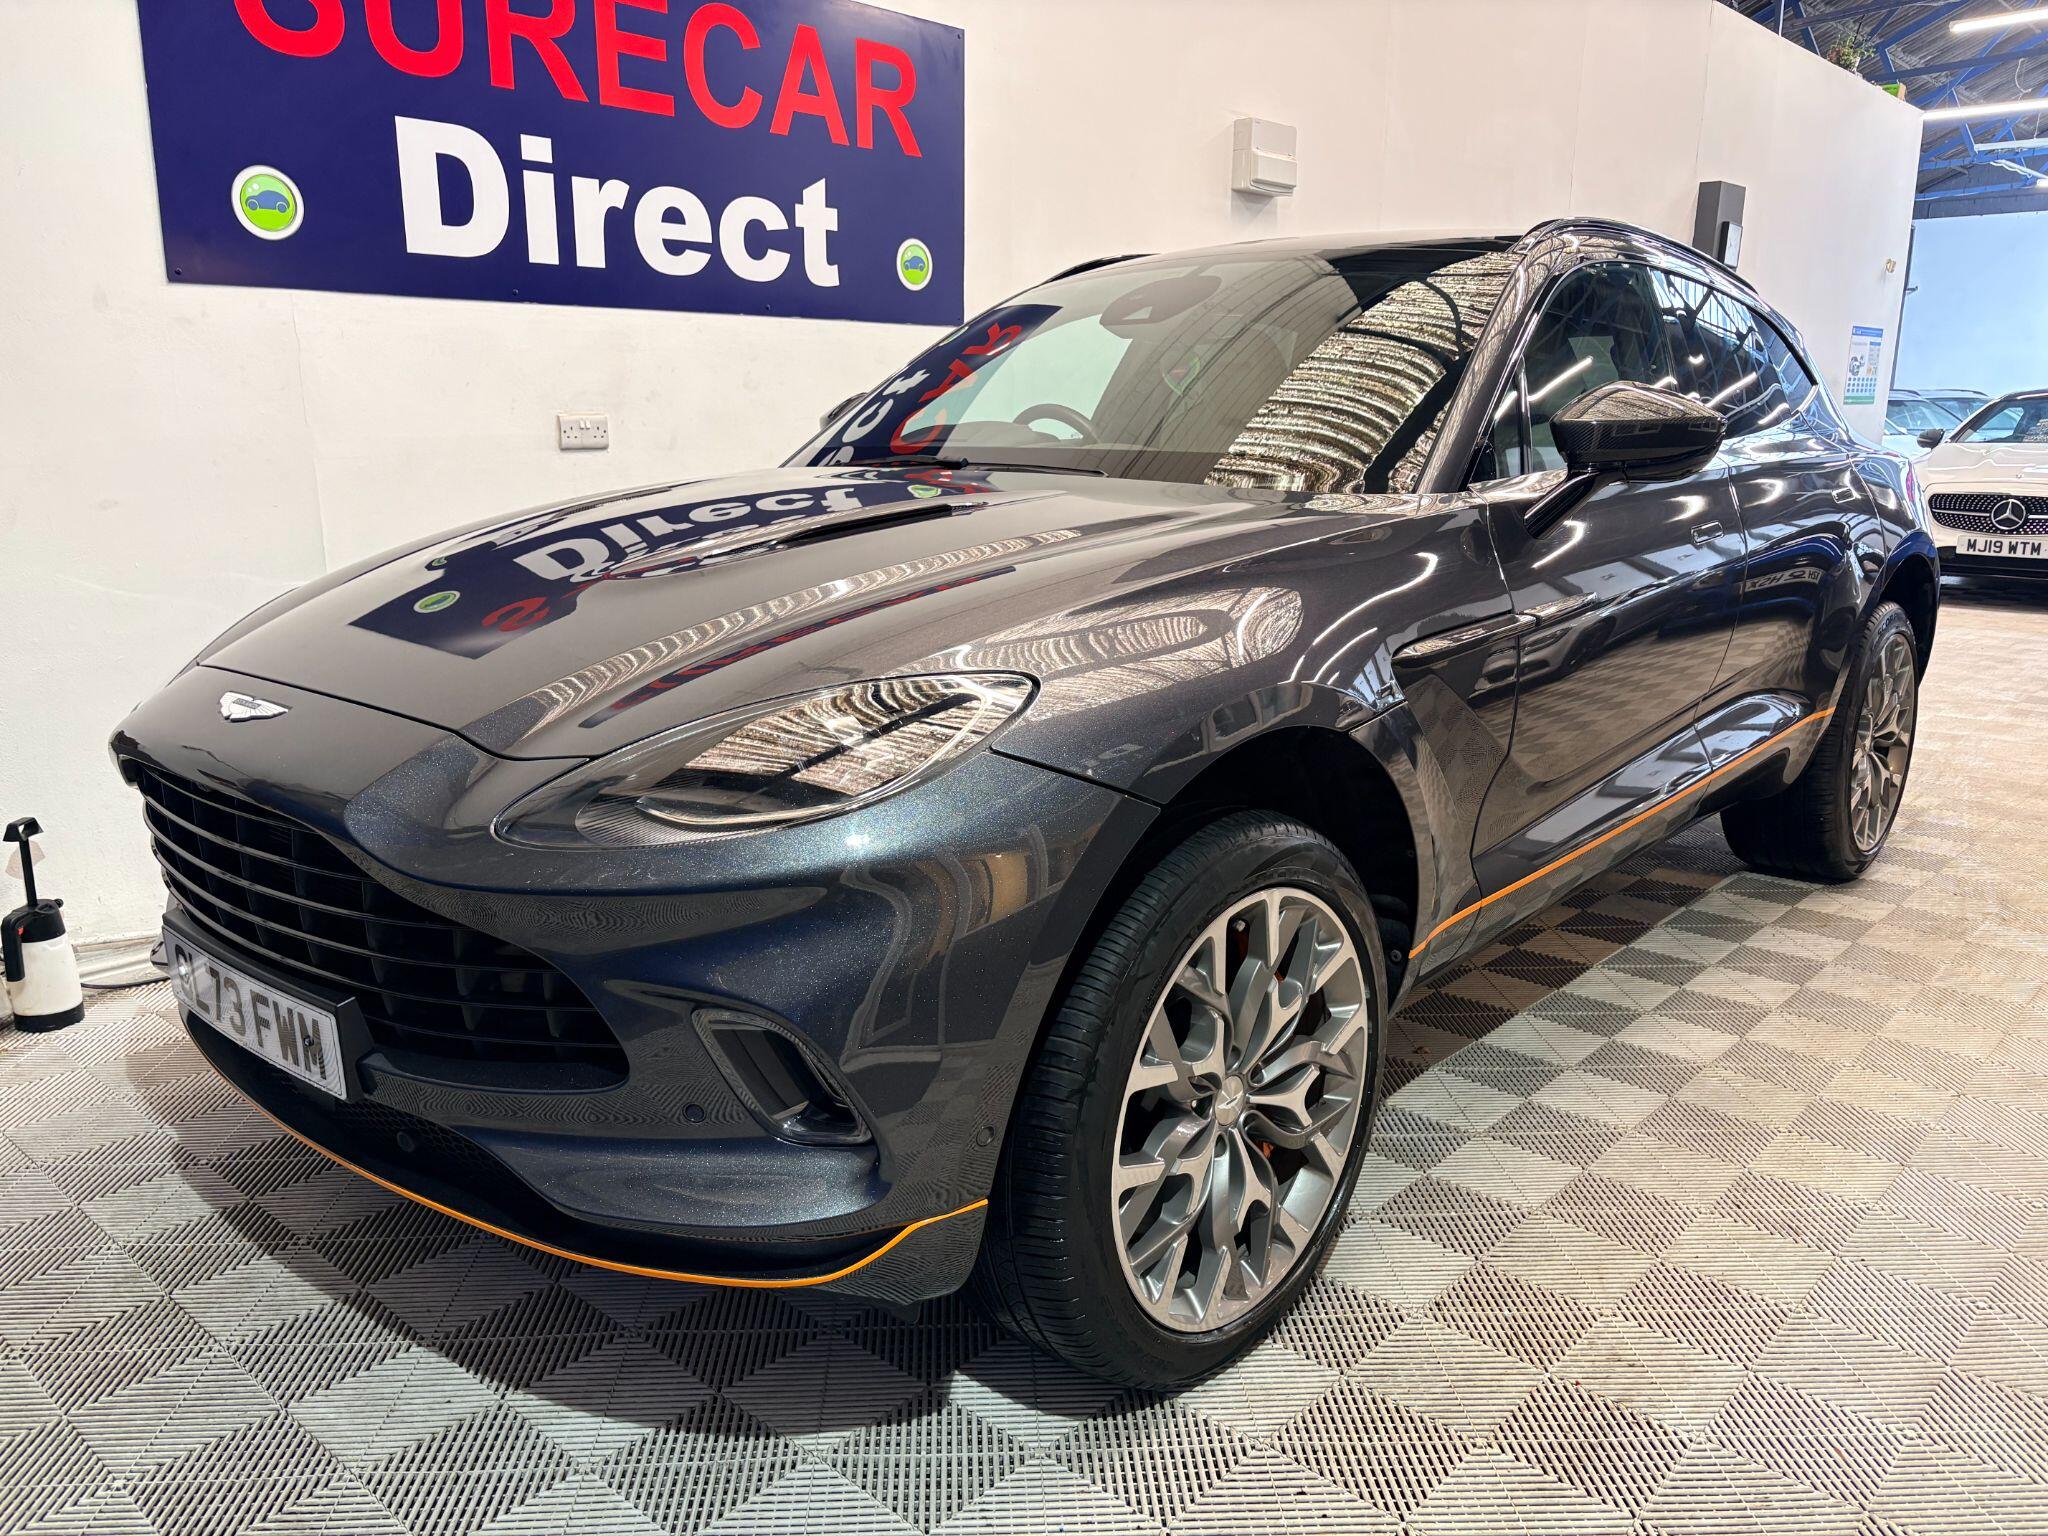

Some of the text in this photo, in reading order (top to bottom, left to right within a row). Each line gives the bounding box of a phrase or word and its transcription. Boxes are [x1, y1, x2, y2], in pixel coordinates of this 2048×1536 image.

[394, 116, 840, 288] Direct
[1966, 538, 2042, 556] MJ19 WTM
[249, 988, 327, 1081] FWM
